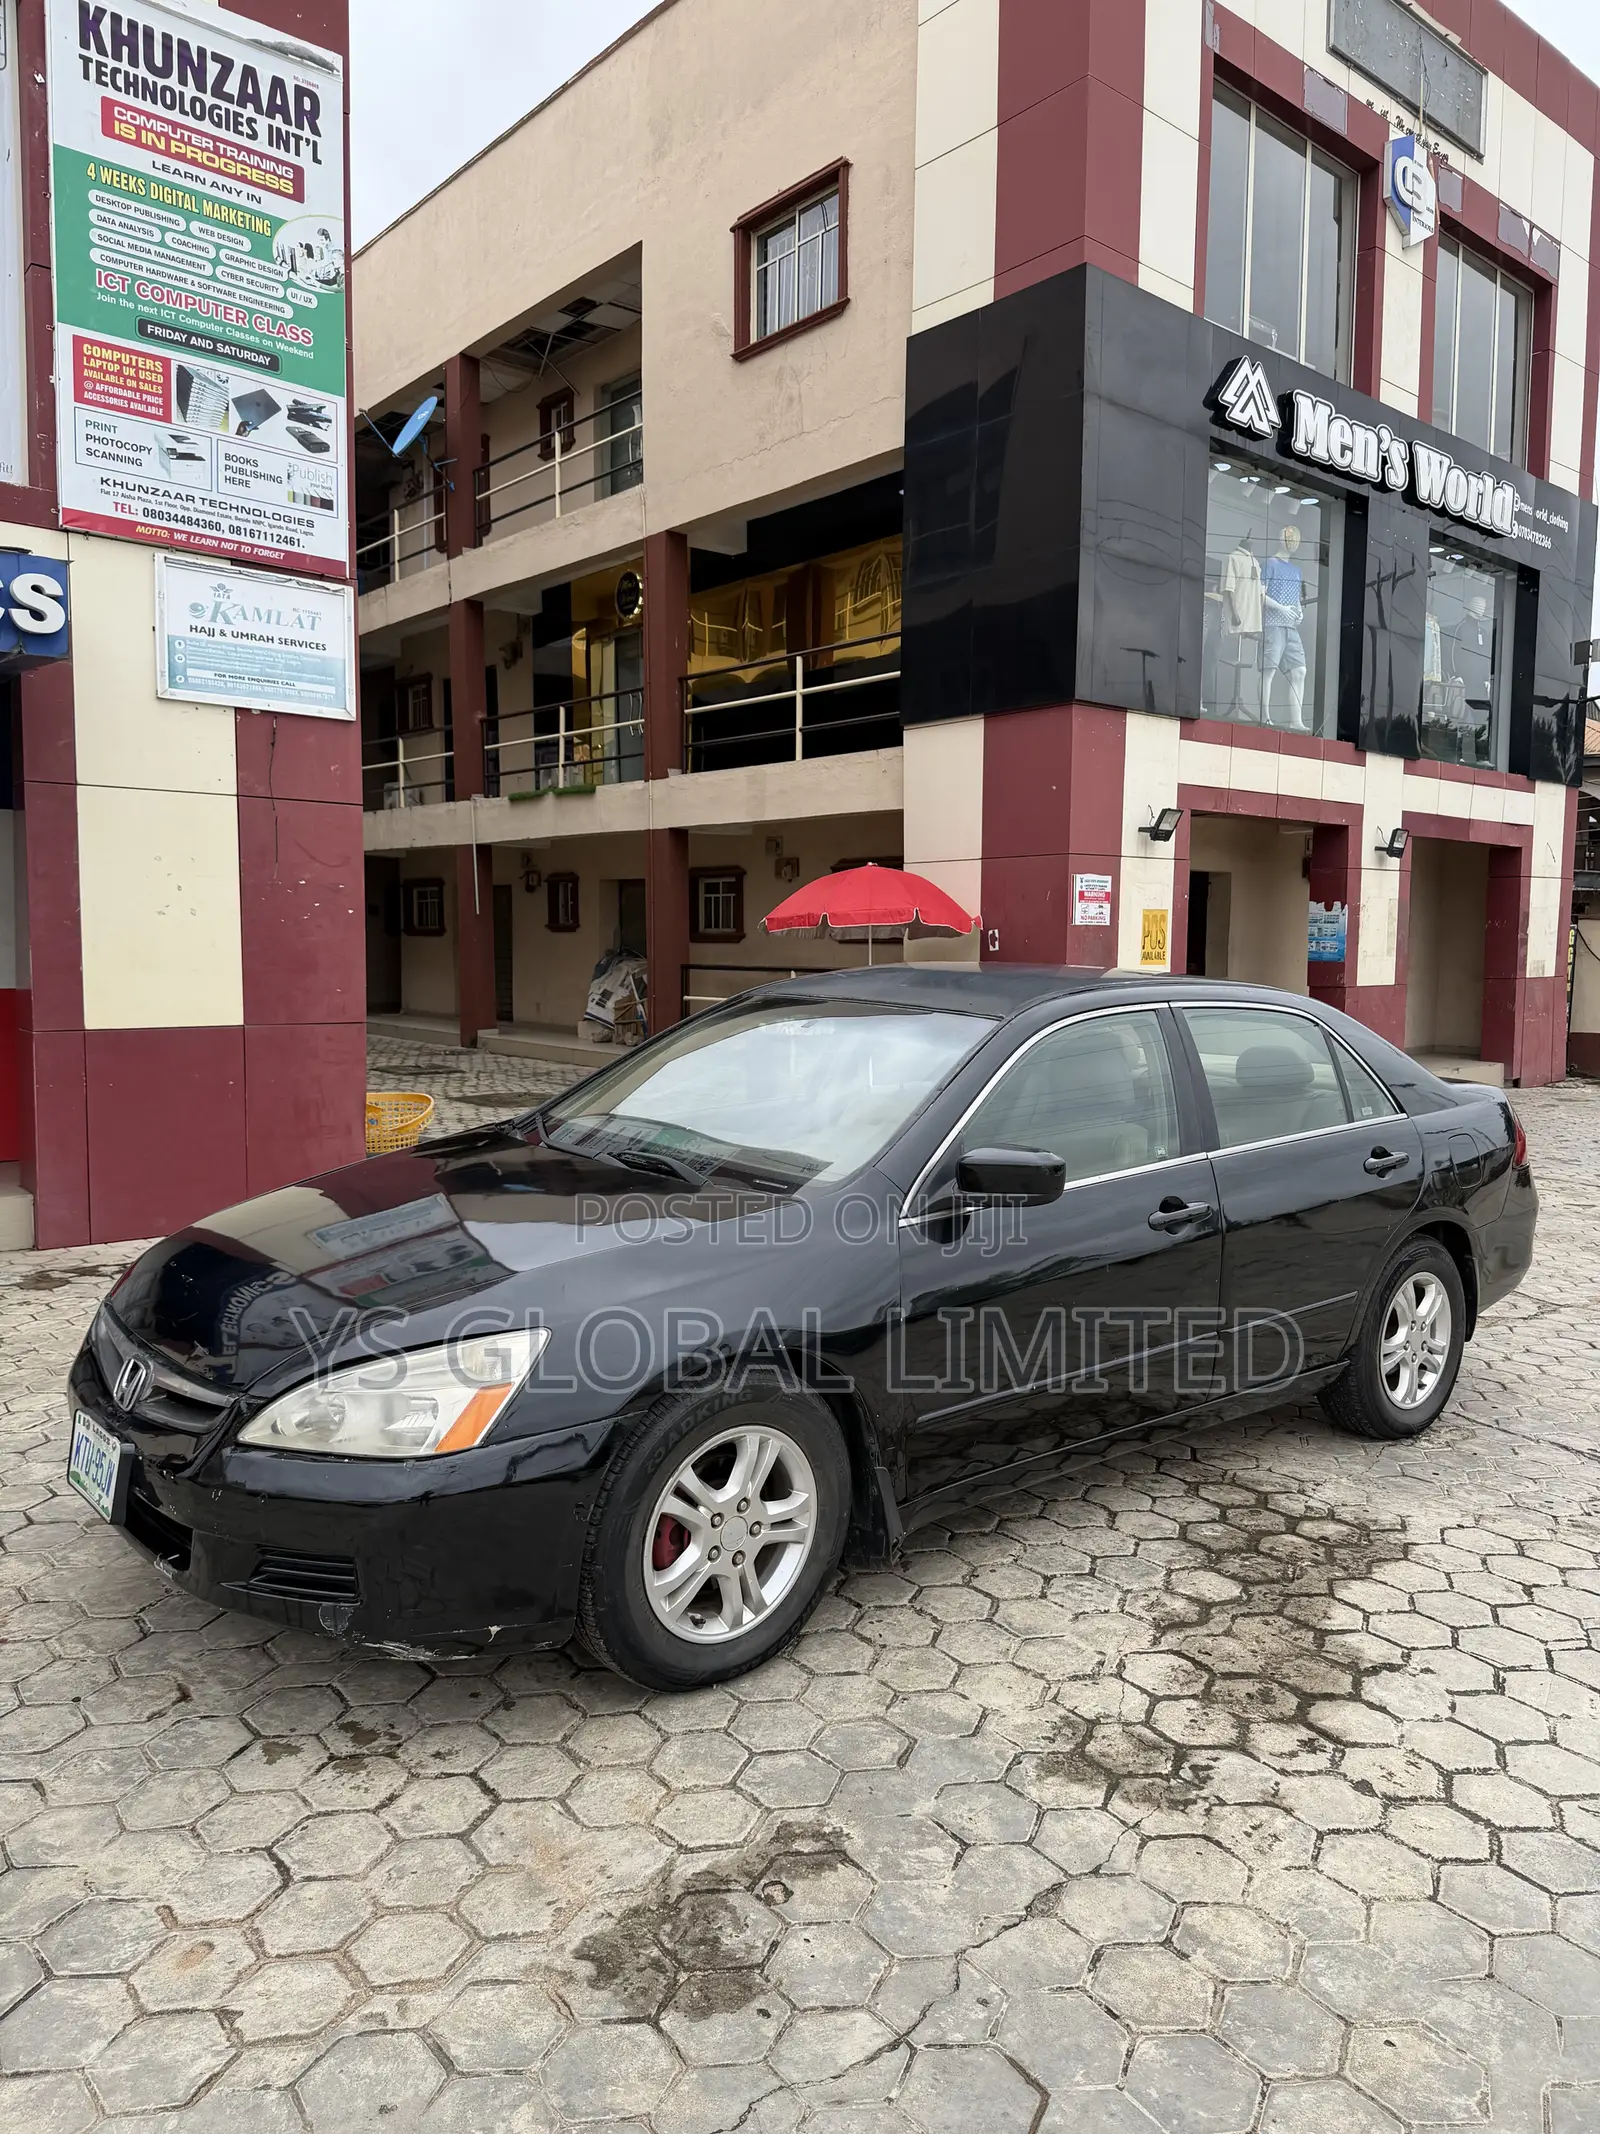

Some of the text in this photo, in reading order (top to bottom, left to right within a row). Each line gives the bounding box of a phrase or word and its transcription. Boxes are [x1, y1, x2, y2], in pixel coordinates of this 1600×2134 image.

[79, 0, 322, 137] KHUNZAAR
[79, 53, 322, 165] TECHNOLOGIES INT'L
[114, 106, 294, 179] COMPUTER TRAINING
[114, 120, 294, 194] IS IN PROGRESS
[152, 160, 262, 205] LEARN ANY IN
[87, 162, 272, 238] 4 WEEKS DIGITAL MARKETING
[95, 194, 180, 227] DESKTOP PUBLISHING
[96, 214, 155, 238] DATA ANALYSIS
[198, 226, 244, 247] WEB DESIGN
[97, 233, 207, 271] SOCIAL MEDIA MANAGEMENT
[171, 236, 210, 254] COACHING
[225, 253, 284, 278] GRAPHIC DESIGN
[100, 253, 286, 314] COMPUTER HARDWARE & SOFTWARE ENGINEERING
[221, 270, 279, 294] CYBER SECURITY
[95, 268, 314, 346] ICT COMPUTER CLASS
[96, 292, 314, 359] Join the next ICT Computer Classes on Weekend
[83, 343, 163, 373] COMPUTERS
[147, 324, 271, 366] FRIDAY AND SATURDAY
[83, 356, 164, 383] LAPTOP UK USED
[83, 368, 163, 394] AVAILABLE ON SALES
[83, 390, 164, 416] ACCESSORIES AVAILABLE
[95, 382, 141, 401] AFFORDABLE
[142, 393, 164, 406] PRICE
[85, 419, 118, 434] PRINT
[85, 433, 153, 455] PHOTOCOPY
[85, 447, 143, 467] SCANNING
[224, 452, 259, 468] BOOKS
[1291, 388, 1517, 538] Men's World
[224, 464, 283, 485] PUBLISHING
[224, 475, 251, 489] HERE
[292, 463, 333, 485] Publish
[100, 476, 315, 529] KHUNZAAR TECHNOLOGIES
[112, 501, 139, 516] TEL:
[136, 525, 286, 560] MOTTO: WE LEARN NOT TO FORGET
[208, 600, 322, 631] KAMLAT
[189, 624, 215, 638] HAJJ
[219, 628, 228, 638] &
[231, 630, 275, 644] UMRAH
[278, 637, 327, 651] SERVICES
